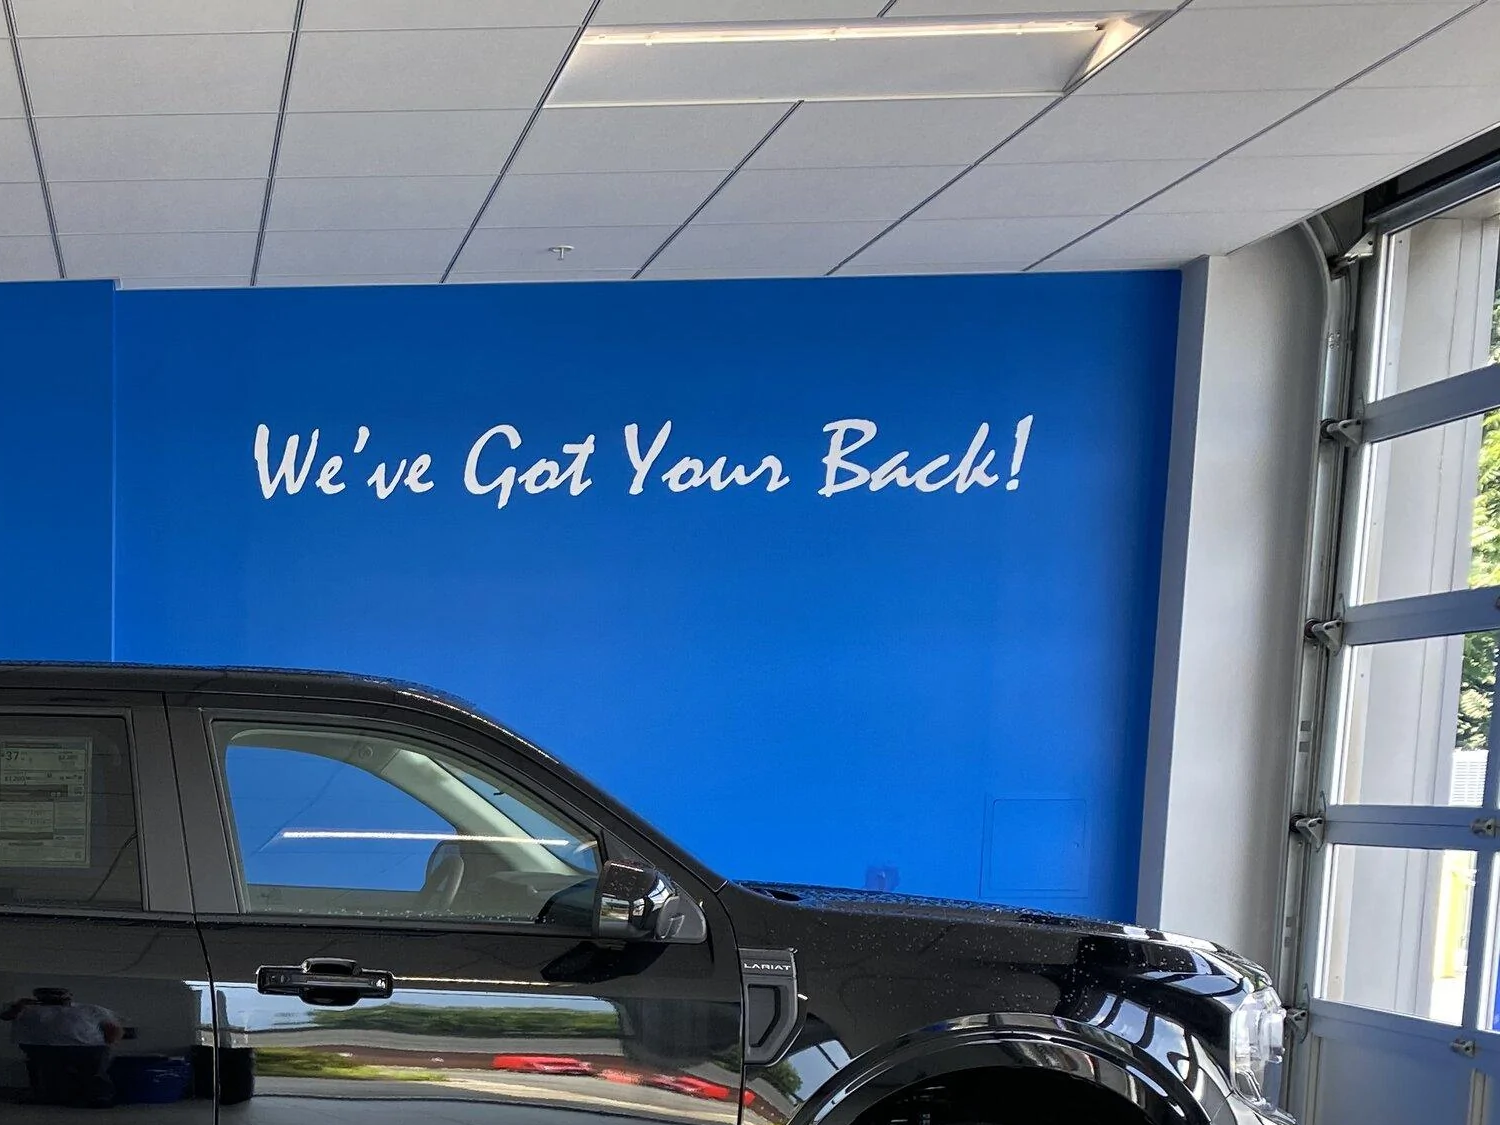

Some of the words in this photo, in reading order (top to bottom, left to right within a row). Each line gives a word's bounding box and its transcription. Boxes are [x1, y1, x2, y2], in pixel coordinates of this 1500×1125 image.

[254, 423, 435, 500] We've
[463, 424, 595, 510] Got
[624, 420, 790, 495] Your
[817, 414, 1033, 498] Back!
[743, 963, 792, 971] LARIAT
